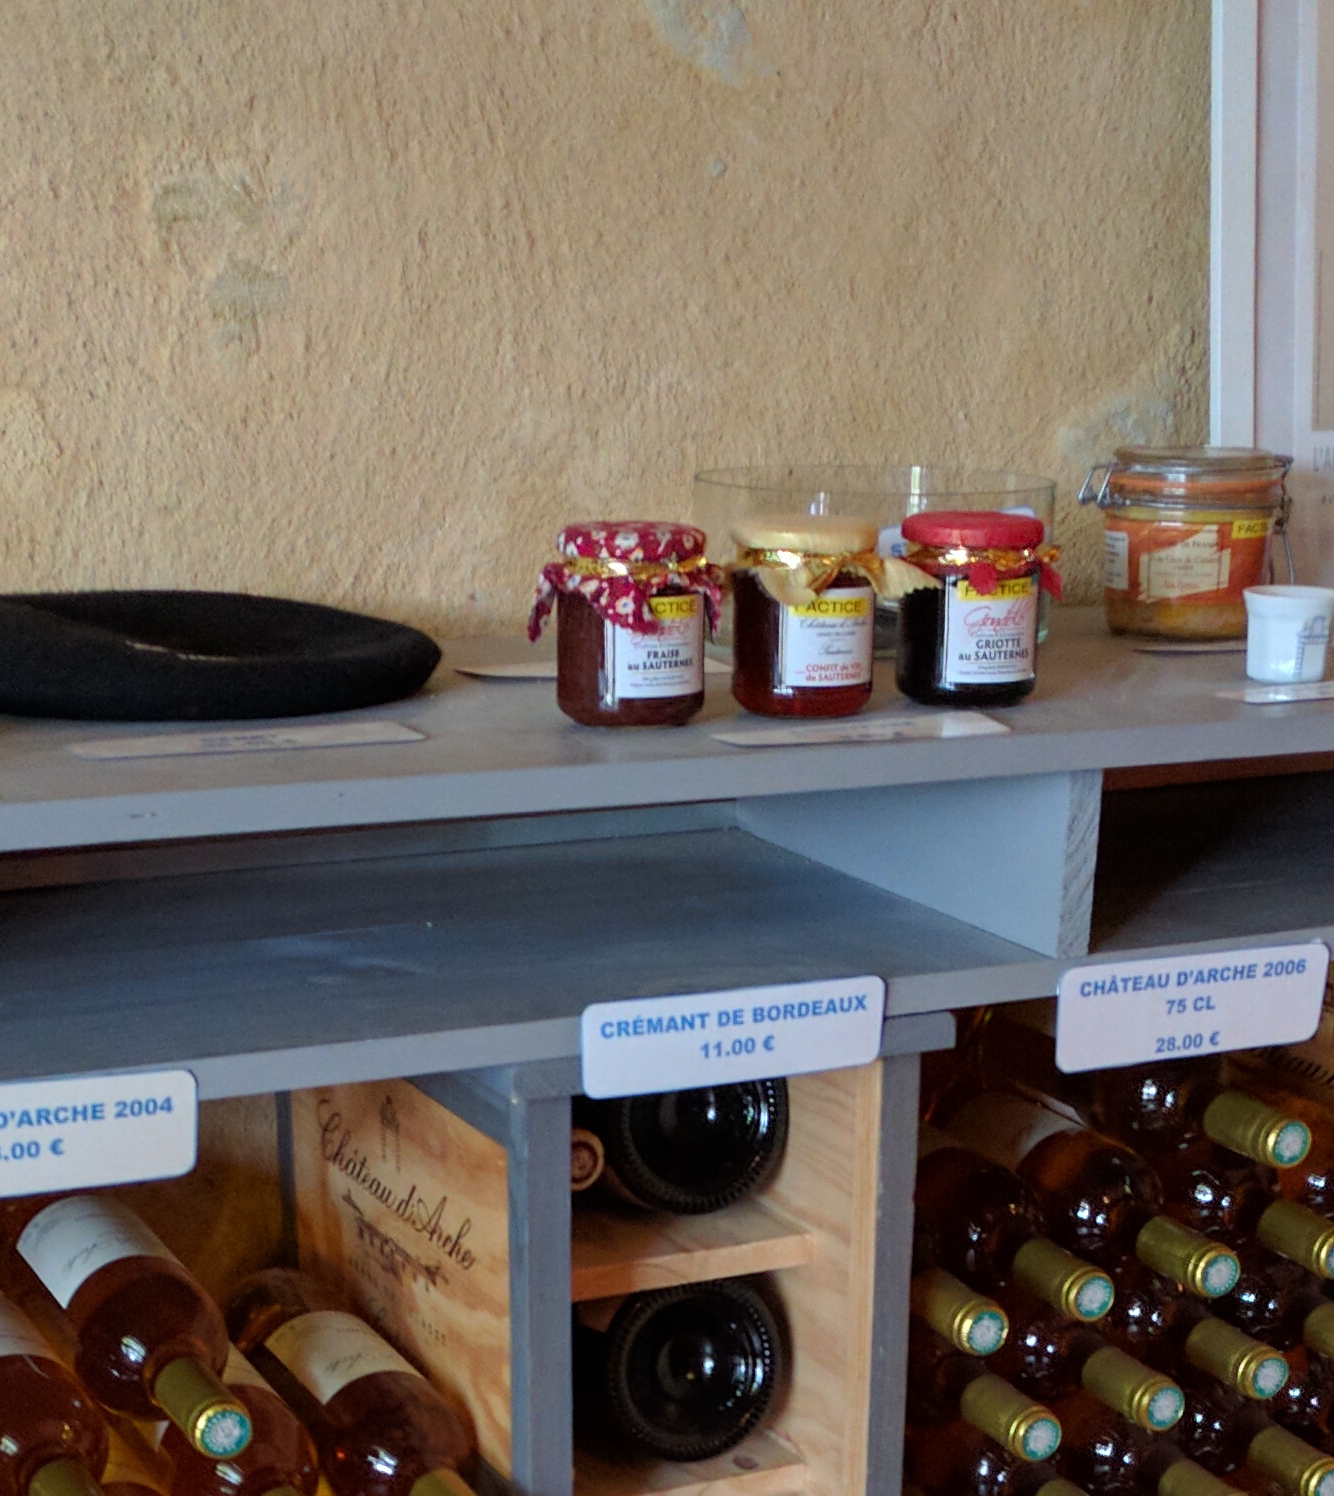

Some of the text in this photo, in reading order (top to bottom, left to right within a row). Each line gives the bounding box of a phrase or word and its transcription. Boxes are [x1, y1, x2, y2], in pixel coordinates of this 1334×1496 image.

[654, 598, 697, 615] CTICE
[975, 637, 1021, 650] GRIOTTE
[627, 657, 693, 671] au SAUTERNES
[647, 648, 680, 660] FRAISE
[958, 647, 1029, 661] au SAUTERNES
[1079, 958, 1307, 998] CHÂTEAU D'ARCHE 2006
[1165, 995, 1216, 1016] 75 CL
[600, 993, 868, 1040] CRÉMANT DE BORDEAUX
[700, 1034, 776, 1059] 11.00 €
[1155, 1030, 1221, 1054] 28.00 €
[114, 1096, 174, 1119] 2004
[48, 1137, 65, 1157] €
